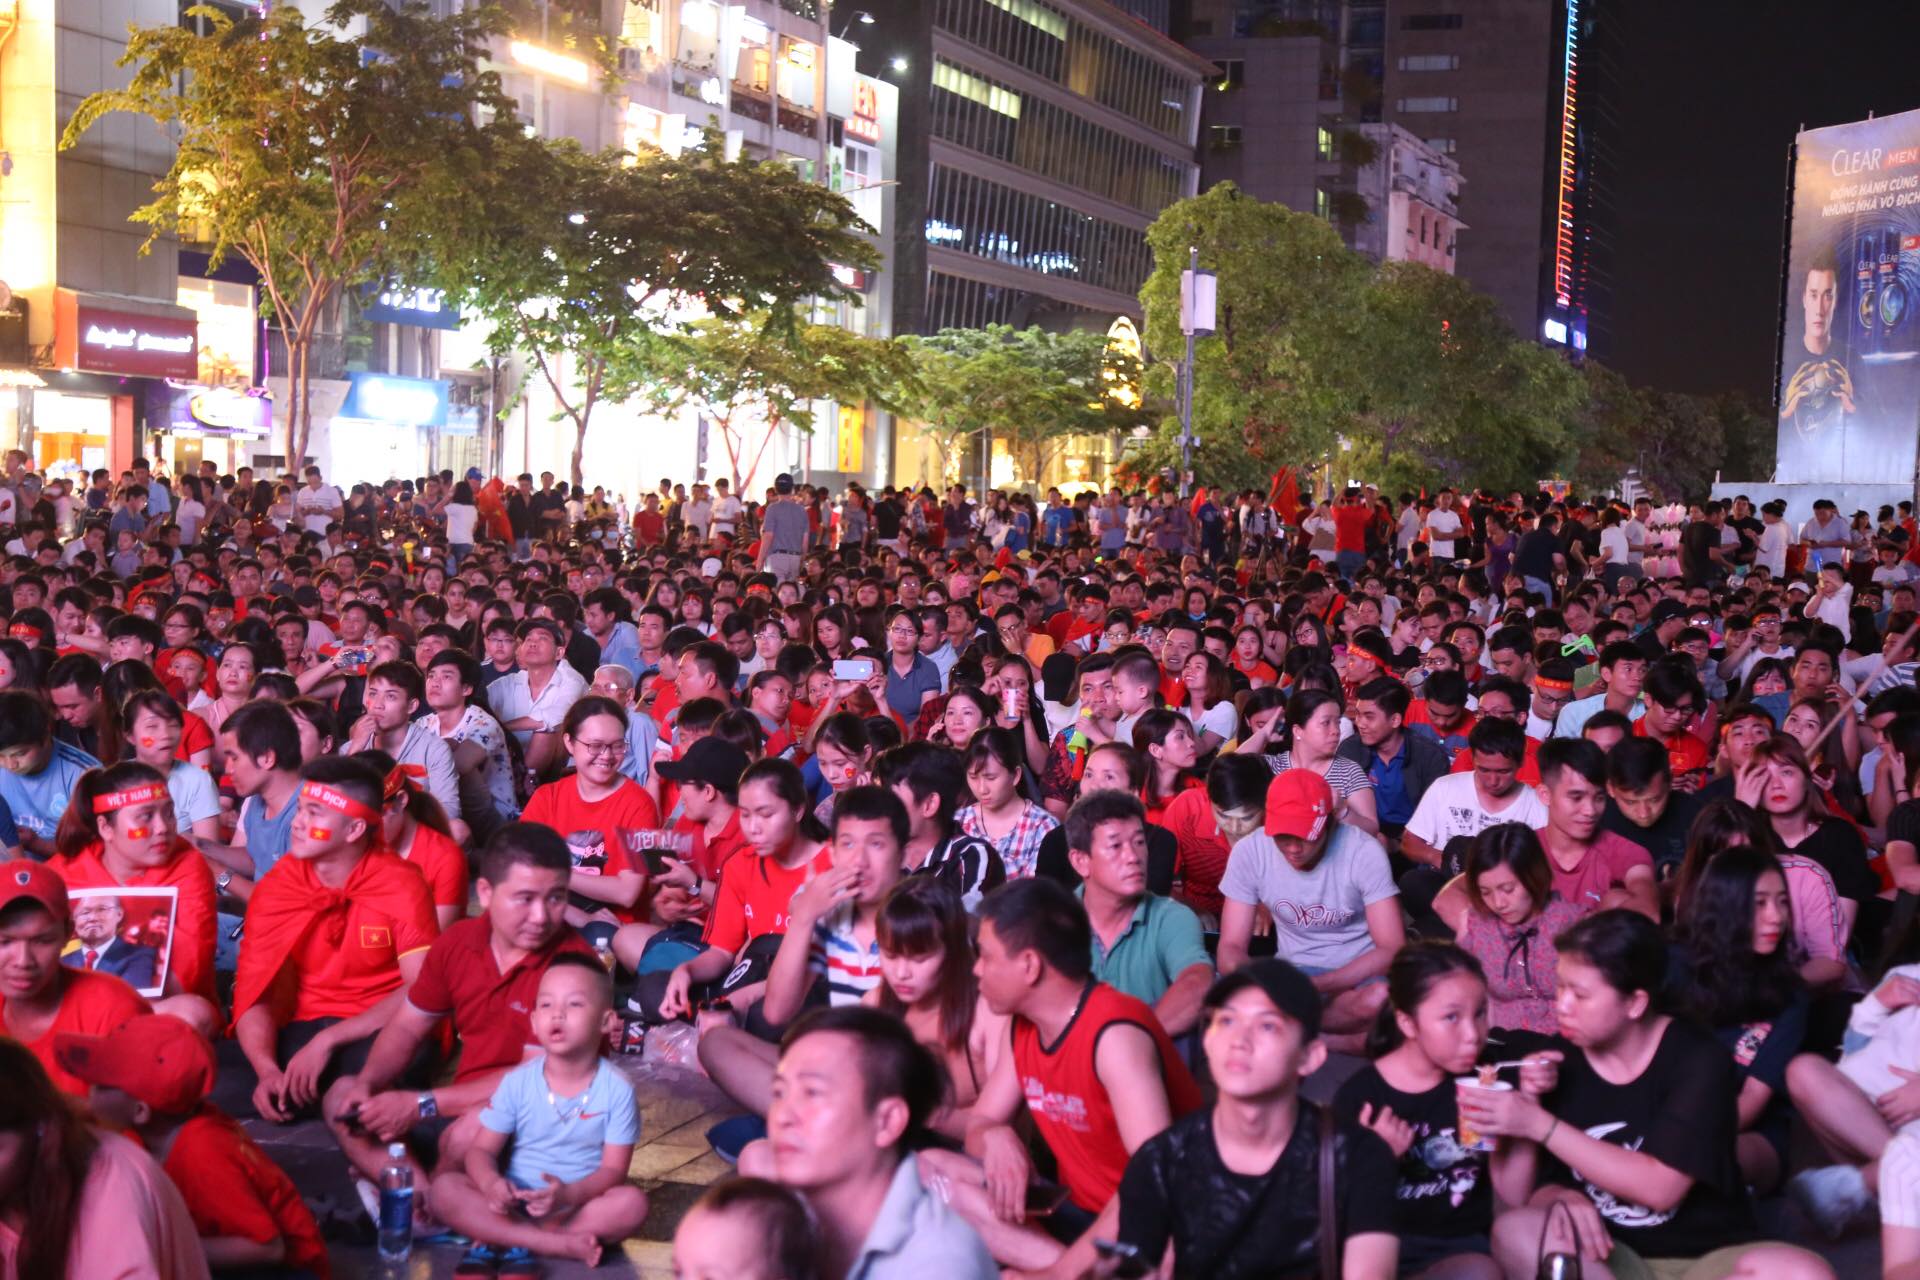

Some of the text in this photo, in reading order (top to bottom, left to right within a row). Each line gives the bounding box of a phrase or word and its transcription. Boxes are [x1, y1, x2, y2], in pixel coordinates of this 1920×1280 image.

[1831, 148, 1917, 177] CLEAR MEN
[130, 787, 153, 801] NAM
